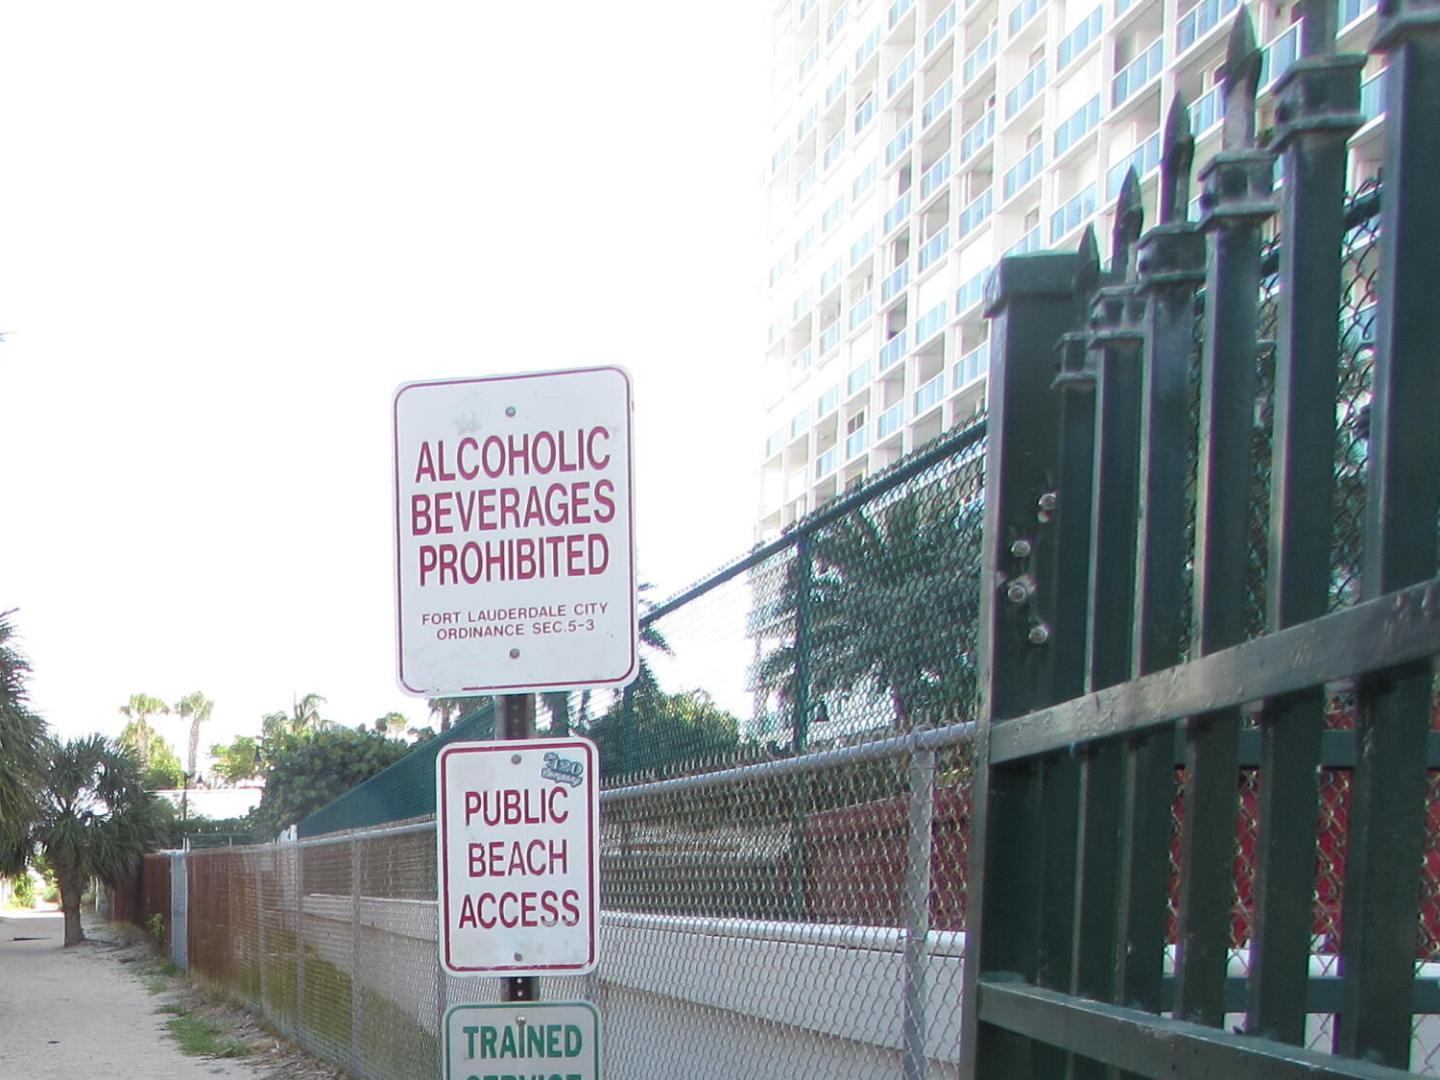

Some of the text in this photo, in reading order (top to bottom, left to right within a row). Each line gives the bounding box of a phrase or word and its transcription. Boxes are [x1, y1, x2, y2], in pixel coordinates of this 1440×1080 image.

[415, 425, 610, 483] ALCOHOLIC
[411, 479, 616, 536] BEVERAGES
[419, 533, 610, 587] PROHIBITED
[422, 602, 608, 626] FORT LAUDERDALE CITY
[436, 623, 524, 640] ORDINANCE
[465, 786, 569, 826] PUBLIC
[468, 839, 567, 878] BEACH
[459, 889, 580, 929] ACCESS
[463, 1024, 583, 1059] TRAINED
